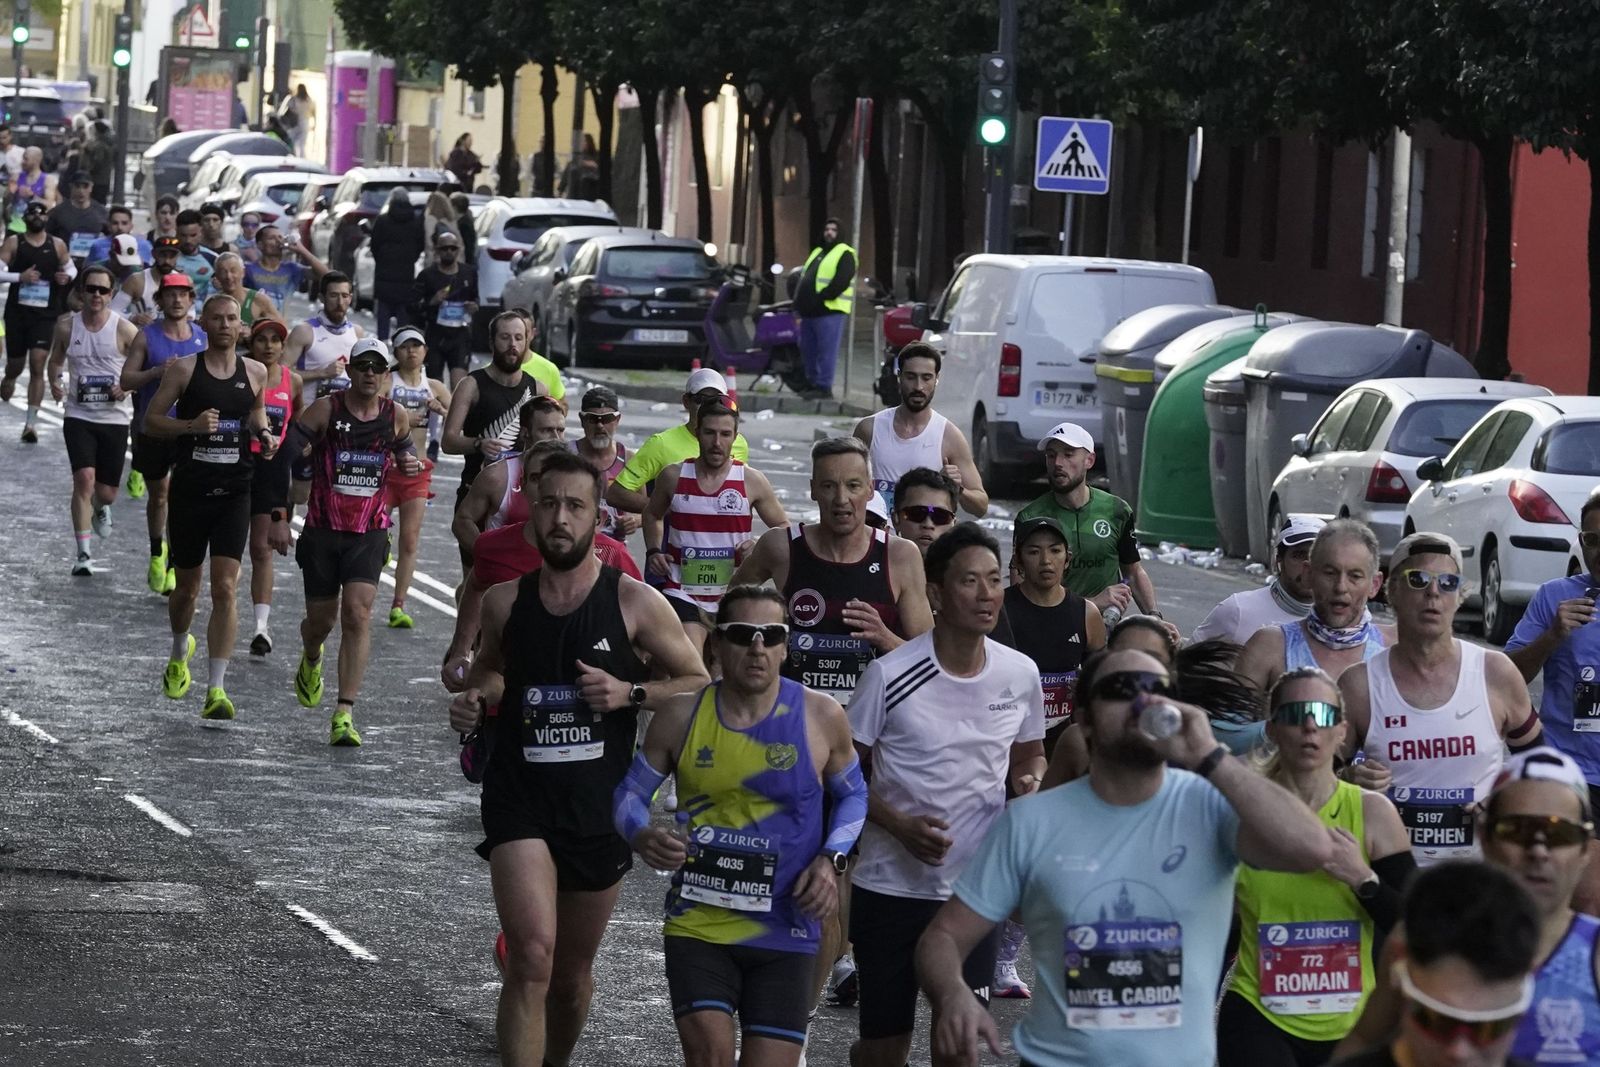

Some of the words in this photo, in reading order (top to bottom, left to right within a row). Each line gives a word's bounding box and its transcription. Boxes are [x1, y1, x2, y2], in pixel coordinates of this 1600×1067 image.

[1043, 391, 1072, 404] 9177
[265, 406, 283, 414] URICH
[217, 421, 236, 429] RICH
[353, 454, 379, 462] ZURICH
[338, 474, 378, 487] IRONDOC
[697, 574, 717, 584] FON
[795, 604, 819, 612] ASV
[819, 640, 860, 649] ZURICH
[818, 659, 841, 669] 5307
[802, 671, 856, 688] STEFAN
[547, 690, 585, 701] ZURIC
[988, 703, 1018, 711] GARMIN
[1061, 702, 1071, 714] R.
[549, 712, 575, 724] 5055
[534, 725, 591, 745] VÍCTOR
[1388, 735, 1476, 761] CANADA
[1416, 789, 1465, 800] ZURICH
[1416, 812, 1444, 823] 5197
[719, 832, 770, 849] ZURICH
[1406, 827, 1465, 844] TEPHEN
[716, 856, 745, 871] 4035
[683, 871, 728, 891] MIGUEL
[731, 880, 772, 896] ANGEL
[1104, 927, 1169, 944] ZURICH
[1294, 926, 1349, 940] ZURICH
[1301, 954, 1324, 967] 772
[1275, 970, 1349, 993] ROMAIN
[1068, 987, 1118, 1005] MIKEL
[1122, 985, 1181, 1005] CABIDA
